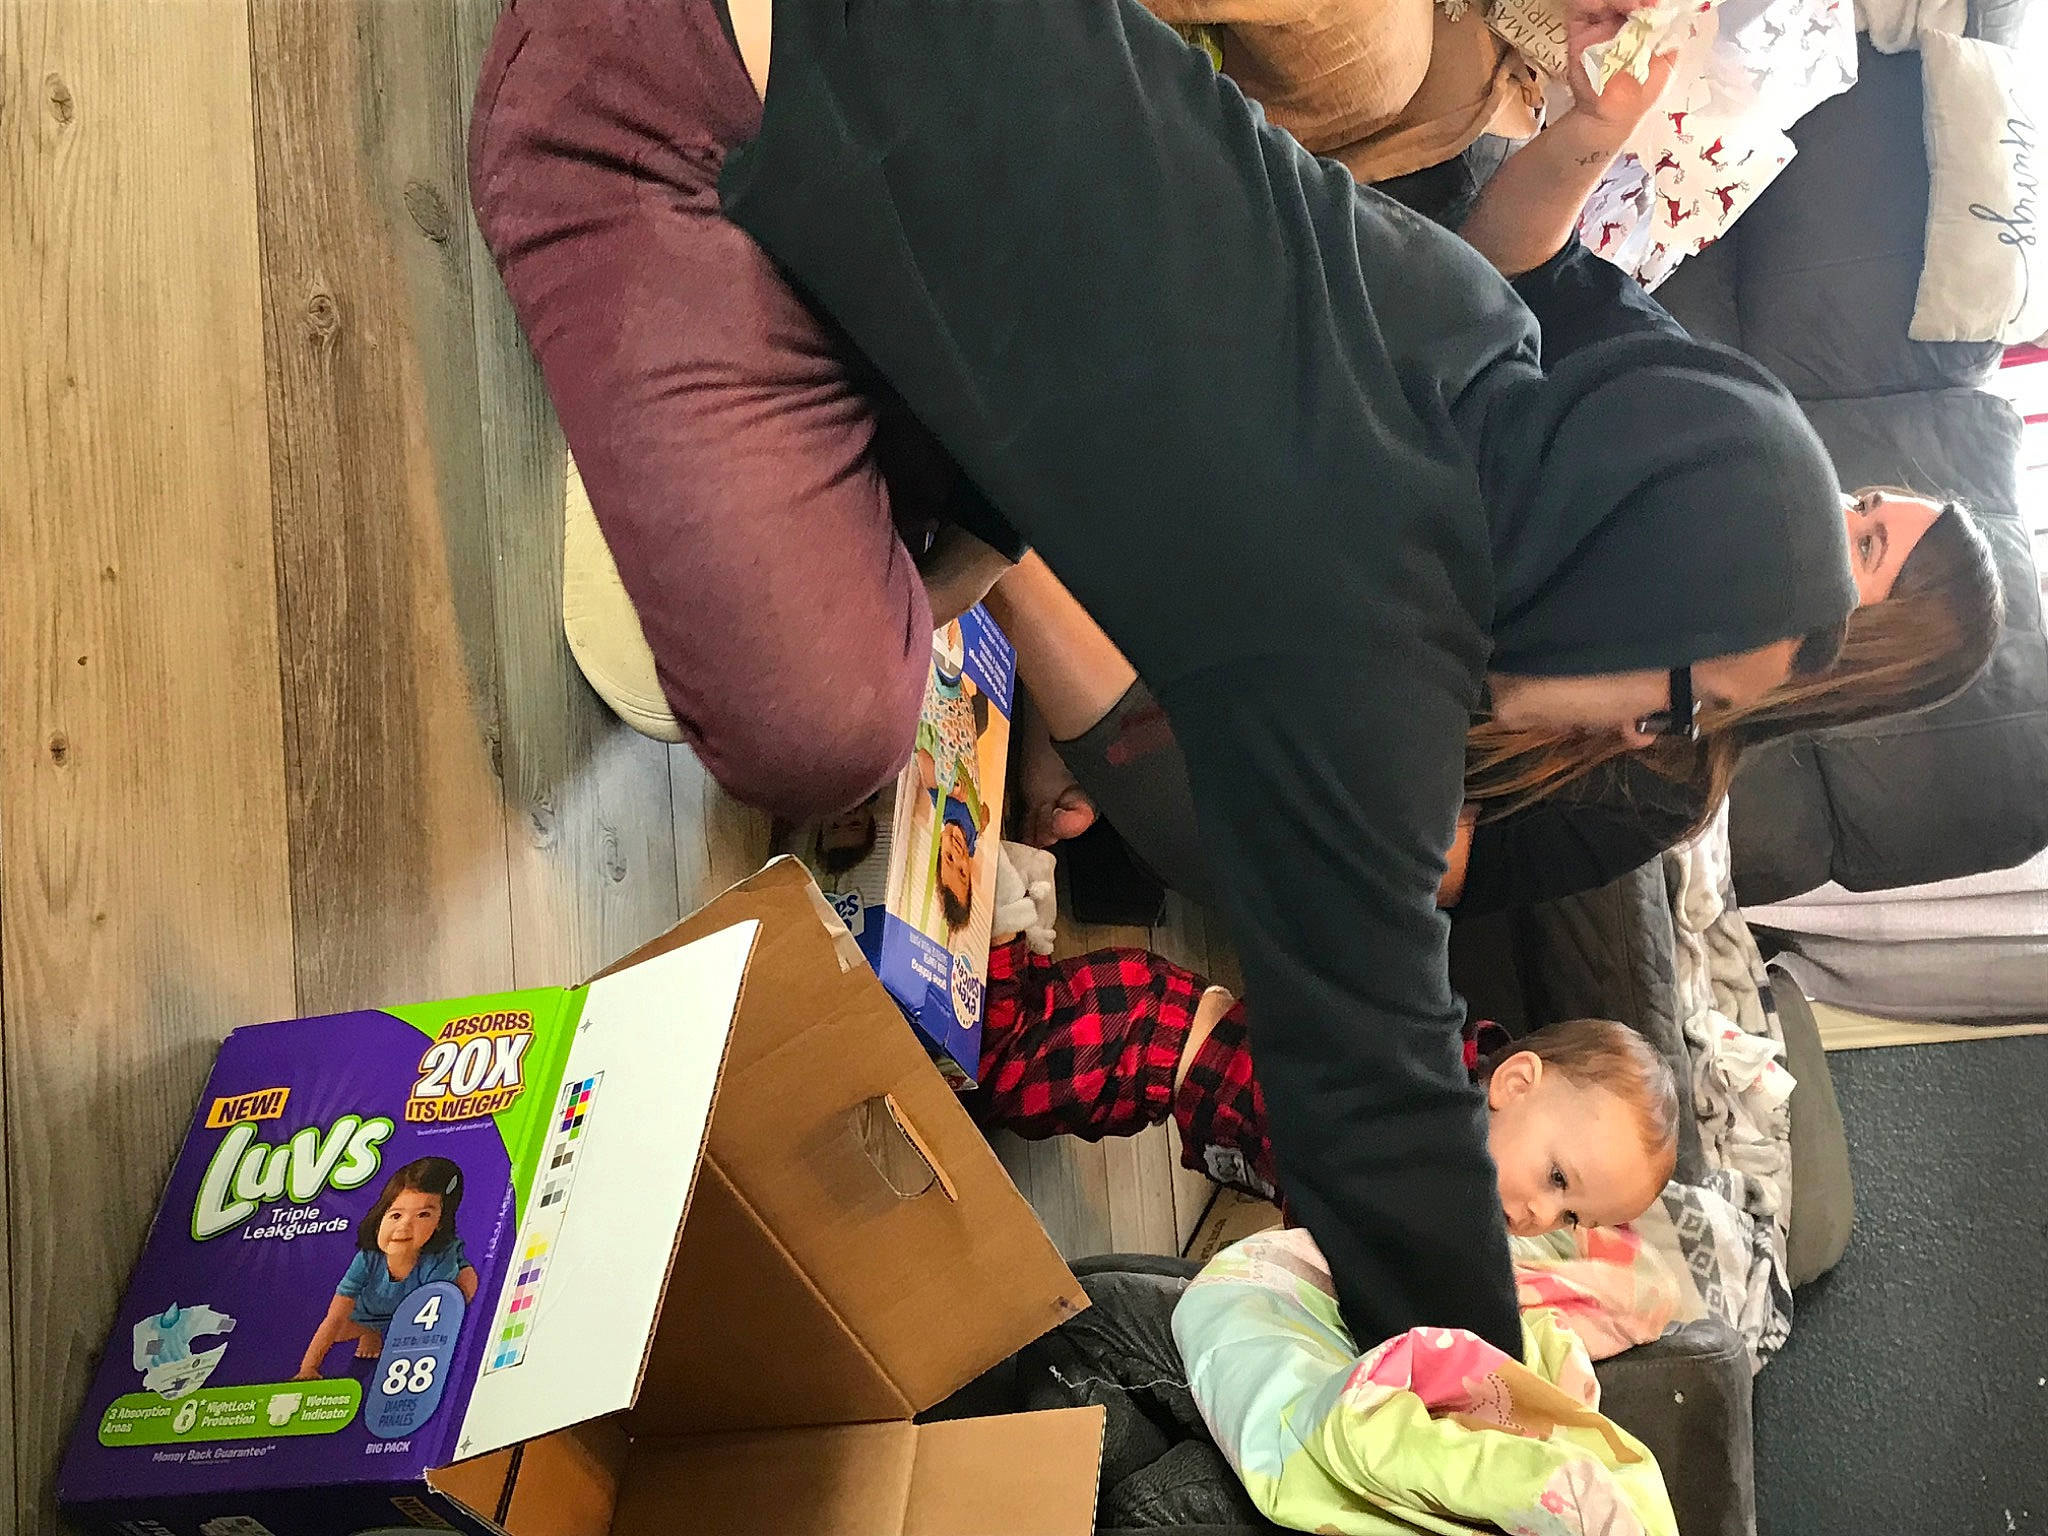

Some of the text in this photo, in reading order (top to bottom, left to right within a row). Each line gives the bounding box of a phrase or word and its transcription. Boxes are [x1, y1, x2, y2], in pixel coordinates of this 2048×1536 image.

[440, 1012, 530, 1039] ABSORBS
[414, 1033, 532, 1097] 20X
[218, 1092, 283, 1123] NEW!
[408, 1101, 437, 1119] ITS
[193, 1115, 394, 1241] Luvs
[271, 1206, 320, 1224] Triple
[243, 1217, 349, 1241] Leakguards
[413, 1295, 442, 1331] 4
[382, 1356, 437, 1395] 88
[306, 1395, 351, 1407] Wetness
[109, 1405, 172, 1420] 3 Absorption
[201, 1414, 256, 1427] Protection
[301, 1408, 350, 1421] Indicator
[104, 1421, 132, 1433] Areas
[366, 1440, 411, 1454] BIG PACK
[152, 1451, 186, 1464] Money
[187, 1449, 212, 1461] Back
